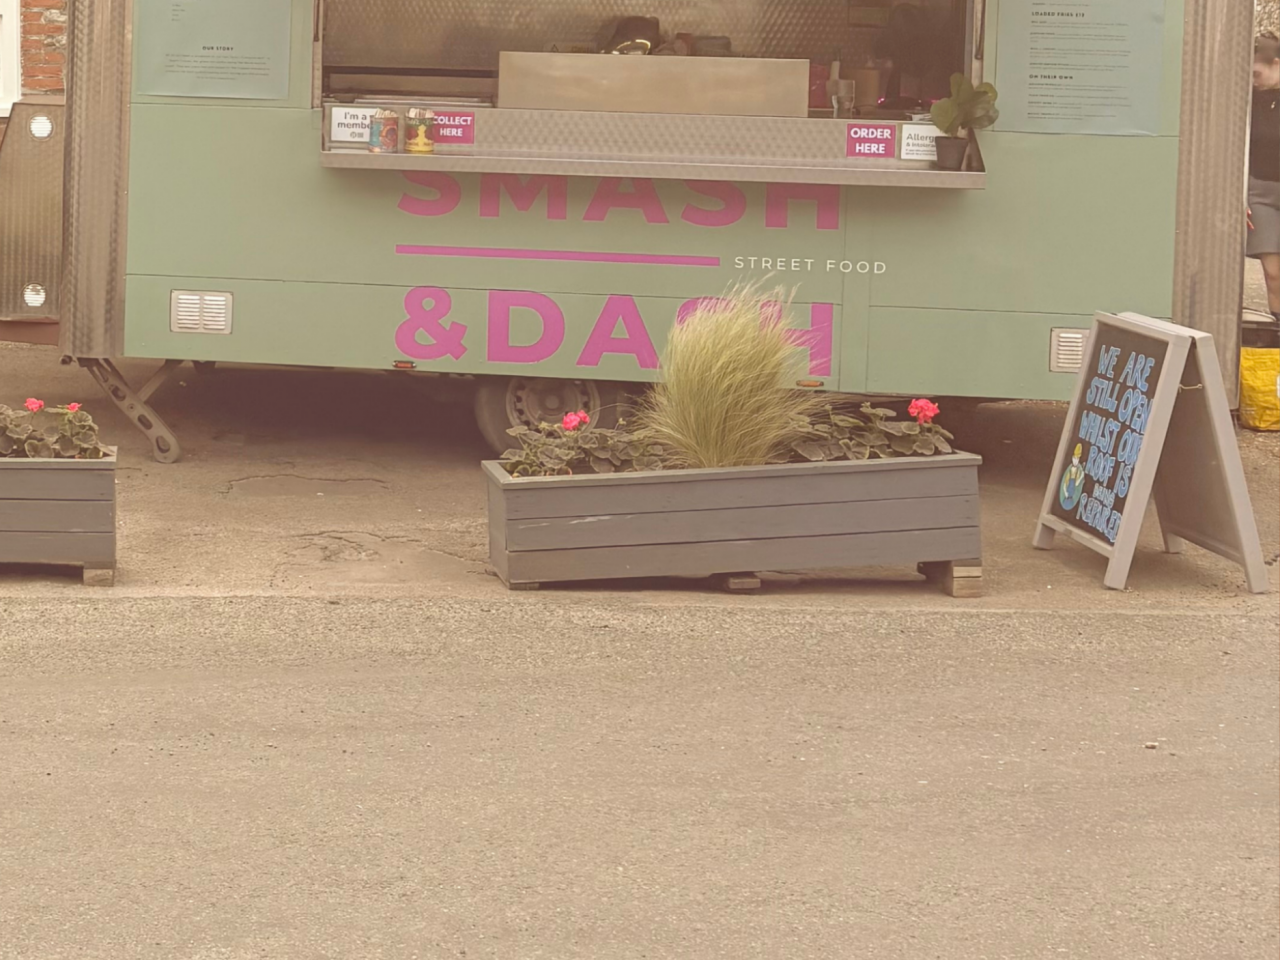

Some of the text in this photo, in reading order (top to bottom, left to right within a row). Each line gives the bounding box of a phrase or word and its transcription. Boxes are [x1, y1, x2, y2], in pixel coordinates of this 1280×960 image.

[337, 121, 372, 129] membe
[344, 111, 359, 120] I'm
[439, 127, 464, 137] HERE
[850, 127, 892, 139] ORDER
[906, 133, 935, 144] Allerg
[855, 142, 886, 154] HERE
[397, 170, 840, 230] SMASH
[734, 256, 887, 274] STREET FOOD
[395, 285, 835, 378] &DAH
[1098, 344, 1156, 392] WE ARE
[1086, 376, 1154, 434] STILL OPEN
[1078, 410, 1121, 455] WHILST
[1085, 445, 1132, 498] ROOF IS
[1092, 482, 1116, 509] BEING
